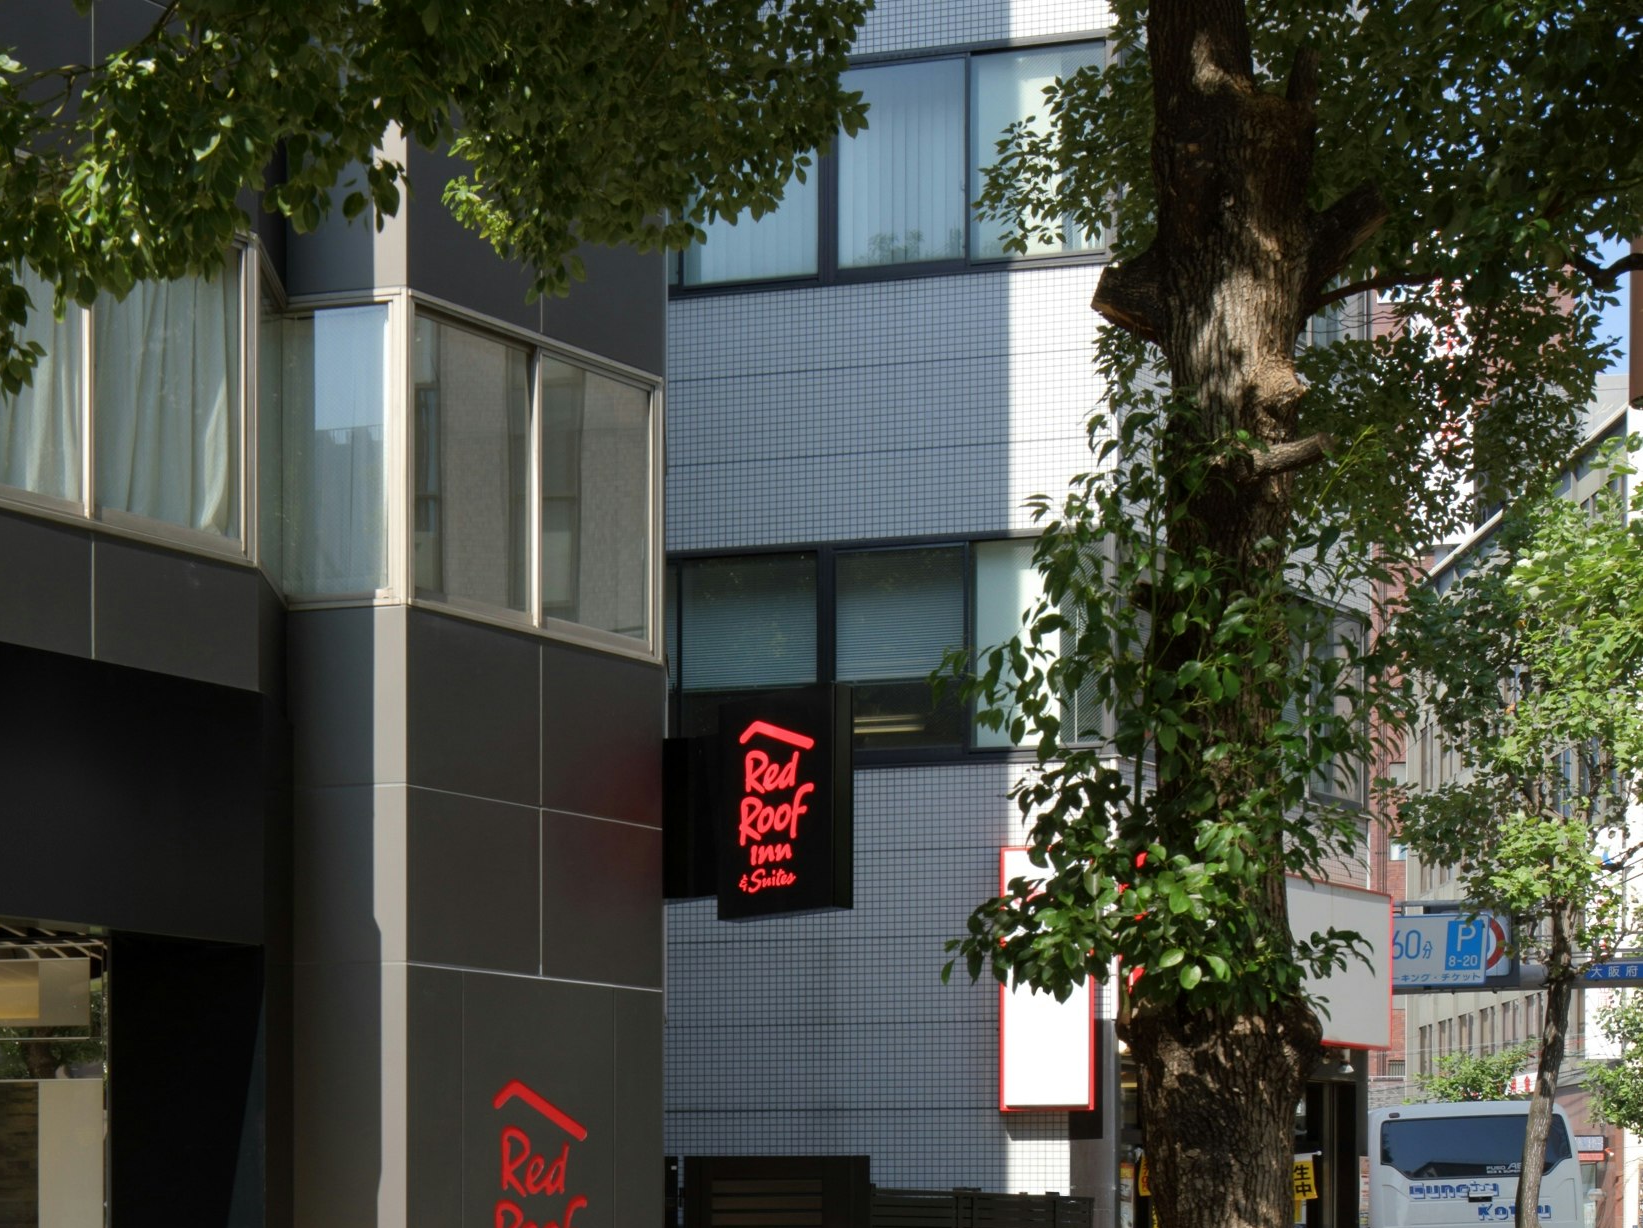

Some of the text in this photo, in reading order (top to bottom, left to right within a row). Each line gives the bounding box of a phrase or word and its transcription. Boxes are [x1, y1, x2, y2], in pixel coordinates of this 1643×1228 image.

[745, 750, 800, 794] Red
[739, 782, 815, 846] Roof
[750, 843, 792, 866] Inn
[1457, 924, 1476, 952] P
[1448, 955, 1478, 967] 8-20
[1591, 966, 1639, 978] 大阪府
[501, 1124, 570, 1197] Red
[1293, 1164, 1313, 1198] 生中
